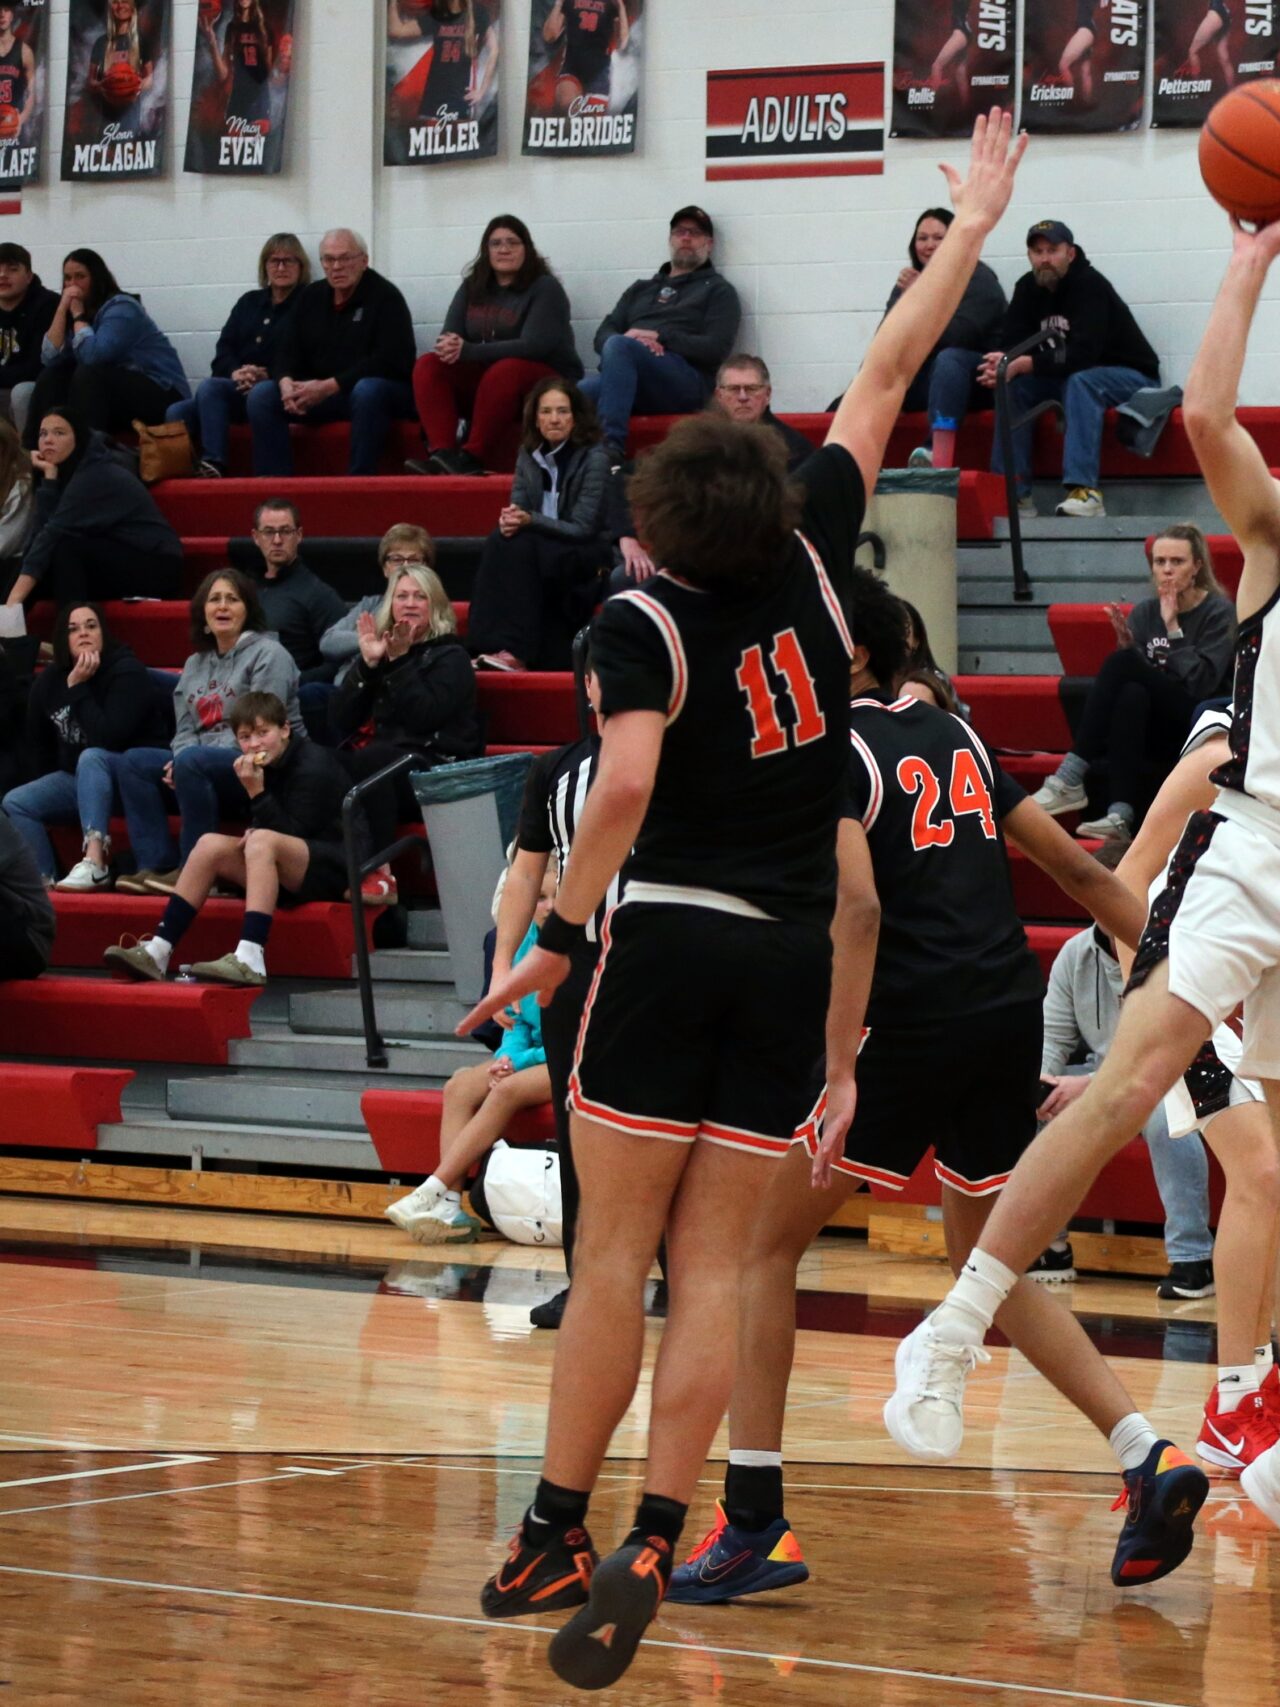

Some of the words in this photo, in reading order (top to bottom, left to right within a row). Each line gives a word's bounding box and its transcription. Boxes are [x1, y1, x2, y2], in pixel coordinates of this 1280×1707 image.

[977, 0, 1006, 51] ATS
[1030, 84, 1074, 101] Erickson
[1158, 78, 1212, 95] Petterson
[433, 103, 459, 134] Zoe
[568, 94, 606, 119] Clara
[741, 92, 847, 144] ADULTS
[100, 122, 134, 149] Sloan
[225, 115, 262, 146] Macy
[408, 121, 480, 157] MILLER
[527, 114, 635, 147] DELBRIDGE
[72, 140, 156, 172] MCLAGAN
[218, 136, 266, 166] EVEN
[736, 627, 826, 760] 11
[896, 749, 997, 852] 24
